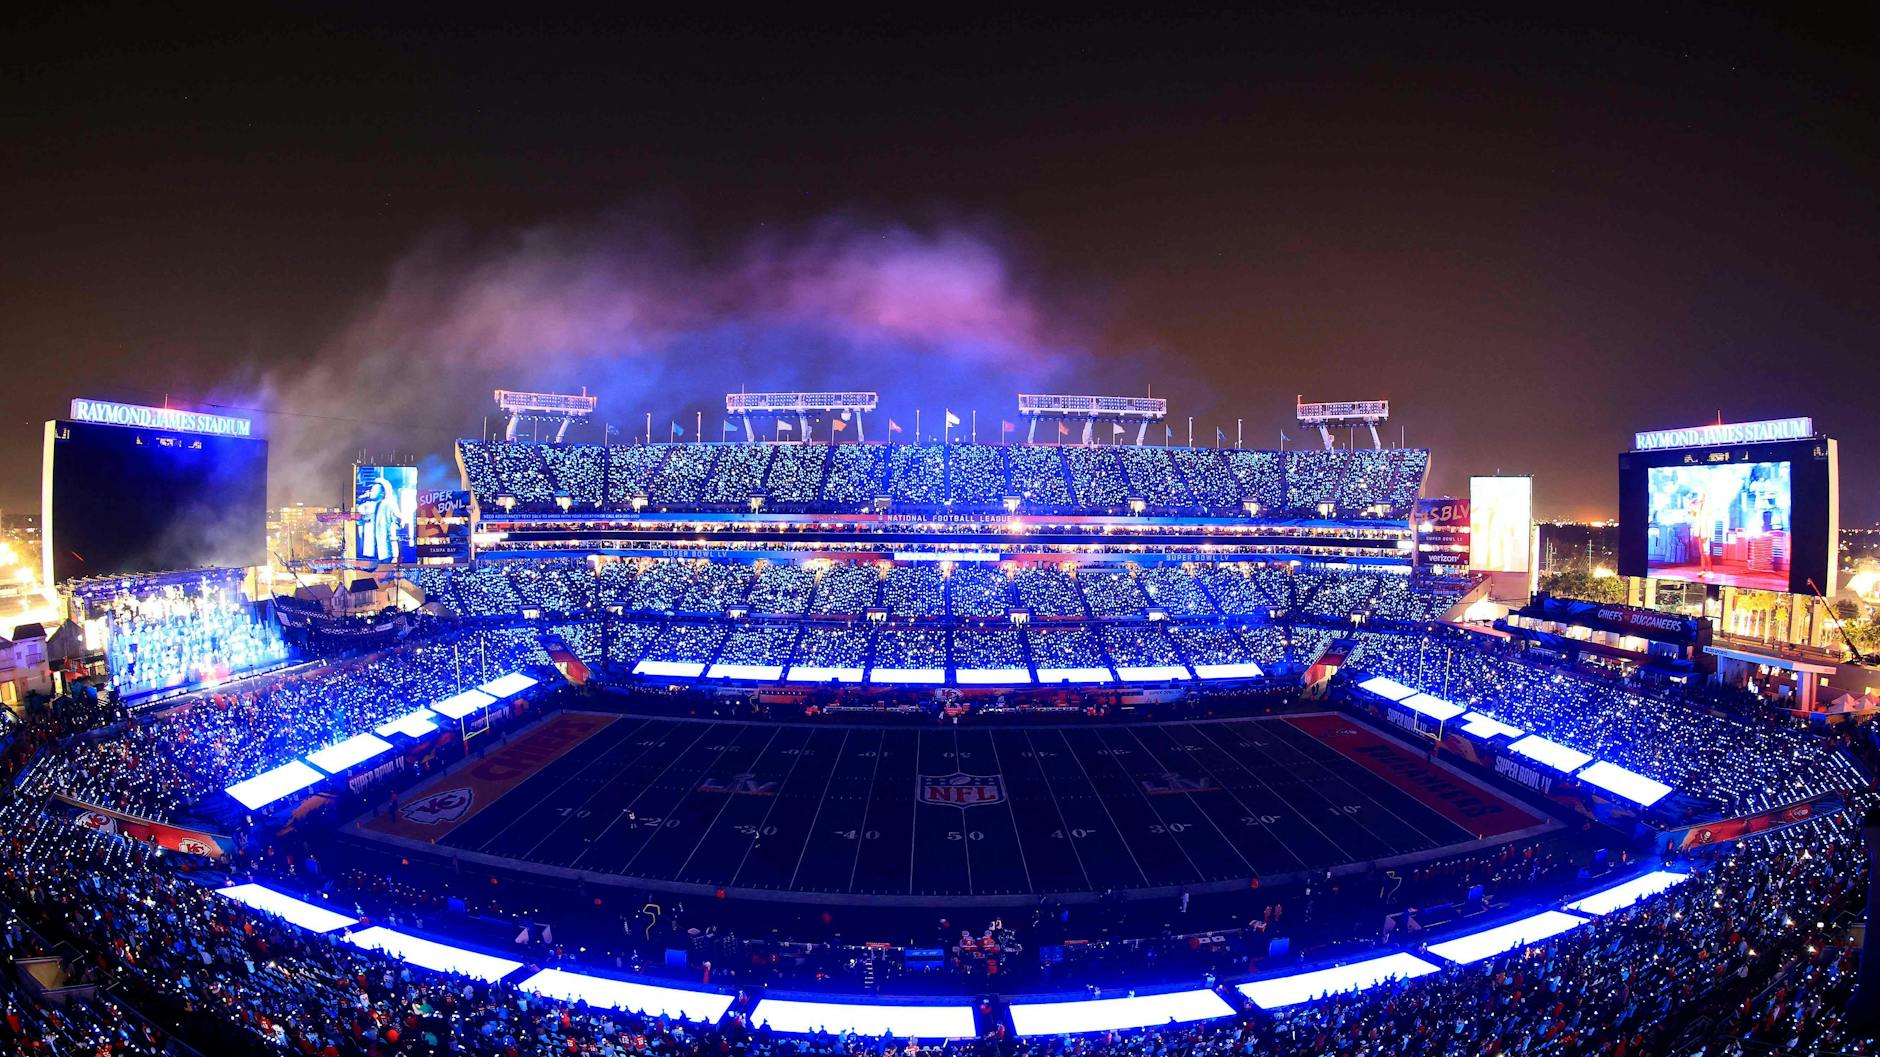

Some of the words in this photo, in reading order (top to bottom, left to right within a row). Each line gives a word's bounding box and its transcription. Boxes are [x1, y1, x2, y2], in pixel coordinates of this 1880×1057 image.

[78, 401, 152, 427] RAYMOND
[153, 410, 196, 431] JAMES
[197, 415, 251, 436] STADIUM
[1636, 430, 1702, 449] RAYMOND
[1702, 424, 1746, 444] JAMES
[1747, 419, 1807, 440] STADIUM
[420, 490, 453, 506] SUPER
[437, 499, 465, 514] BOWL
[692, 550, 714, 558] BOWL
[1166, 553, 1192, 561] SUPER
[1428, 553, 1458, 562] verizon
[1597, 608, 1623, 622] CHIEFS
[1630, 613, 1682, 632] BUCCANEERS
[1495, 755, 1519, 779] SUPER
[1518, 765, 1541, 790] BOWL
[1540, 776, 1552, 795] LV
[349, 770, 373, 794] SUPER
[928, 785, 998, 802] NFL
[643, 816, 681, 828] 20
[1241, 815, 1276, 826] 20
[842, 829, 881, 840] 40
[1050, 828, 1088, 839] 40
[1148, 823, 1185, 834] 30
[946, 830, 985, 840] 50
[186, 842, 205, 855] KC
